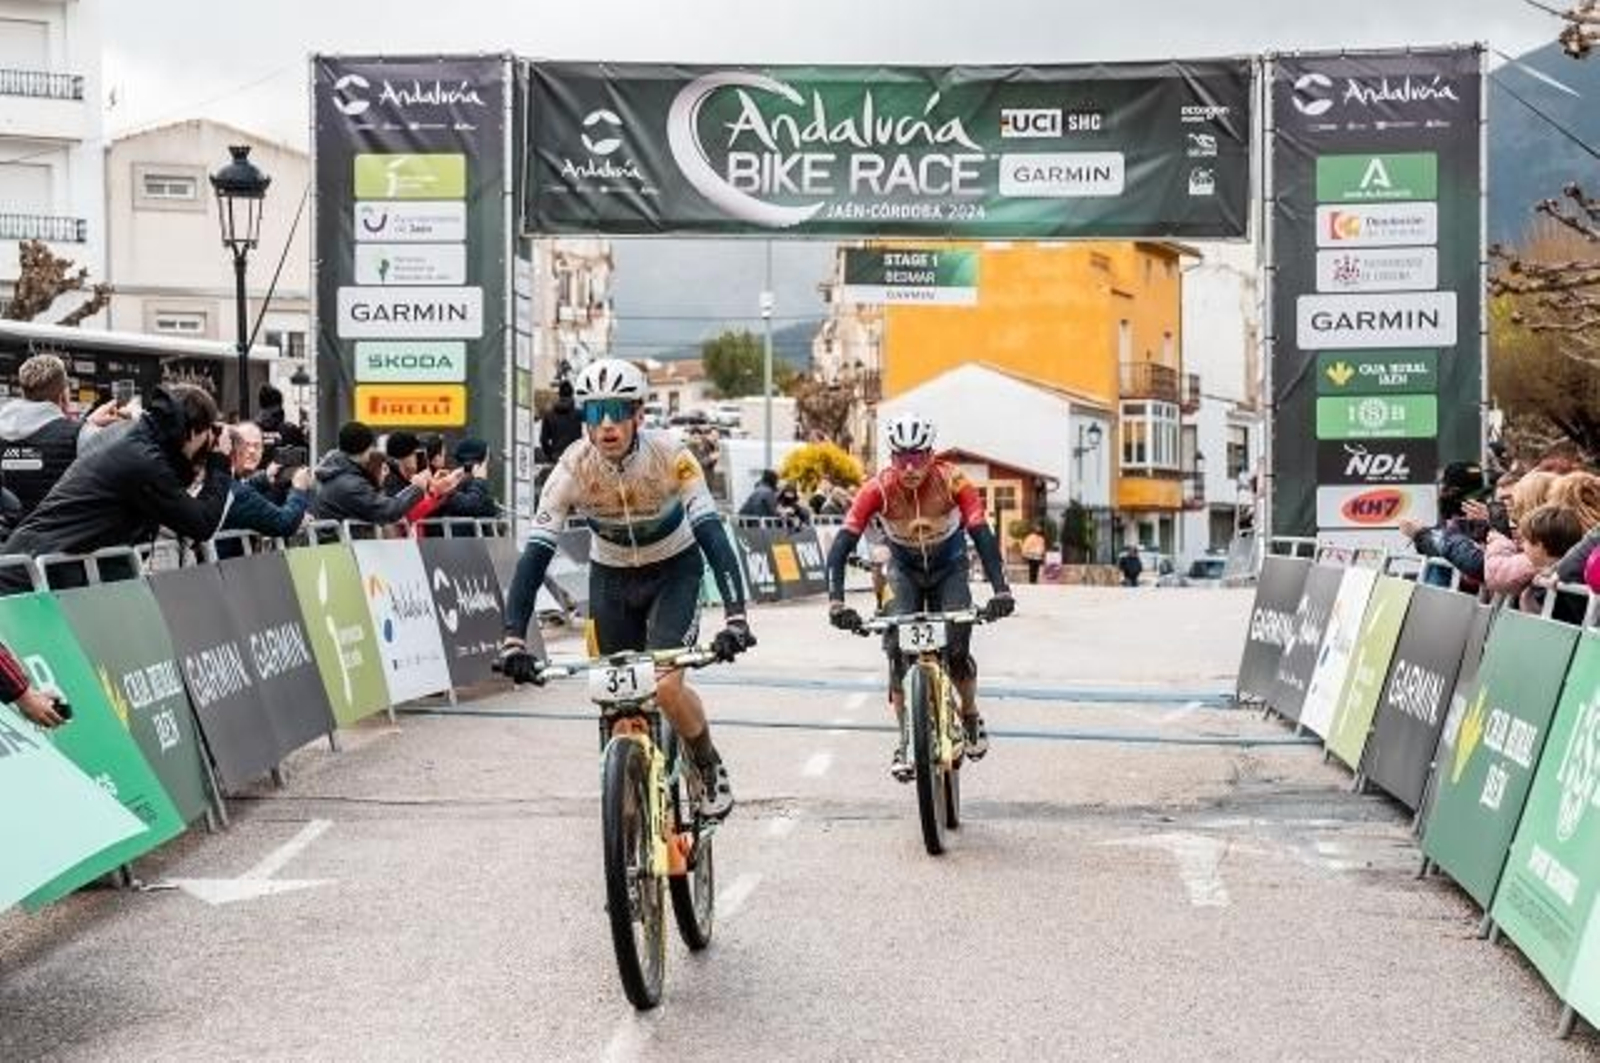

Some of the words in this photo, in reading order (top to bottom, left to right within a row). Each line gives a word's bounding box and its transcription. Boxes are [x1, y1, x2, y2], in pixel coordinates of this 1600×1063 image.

[724, 88, 983, 152] Andalucía
[1011, 113, 1057, 133] UCI
[727, 152, 836, 195] BIKE
[850, 152, 986, 196] RACE
[1013, 165, 1112, 183] GARMIN
[948, 202, 987, 219] 2024
[883, 253, 928, 267] STAGE
[351, 303, 468, 323] GARMIN
[1311, 309, 1438, 332] GARMIN
[1344, 453, 1411, 476] NDL
[1351, 498, 1399, 517] KH7
[911, 624, 934, 645] 3-2
[606, 667, 637, 693] 3-1
